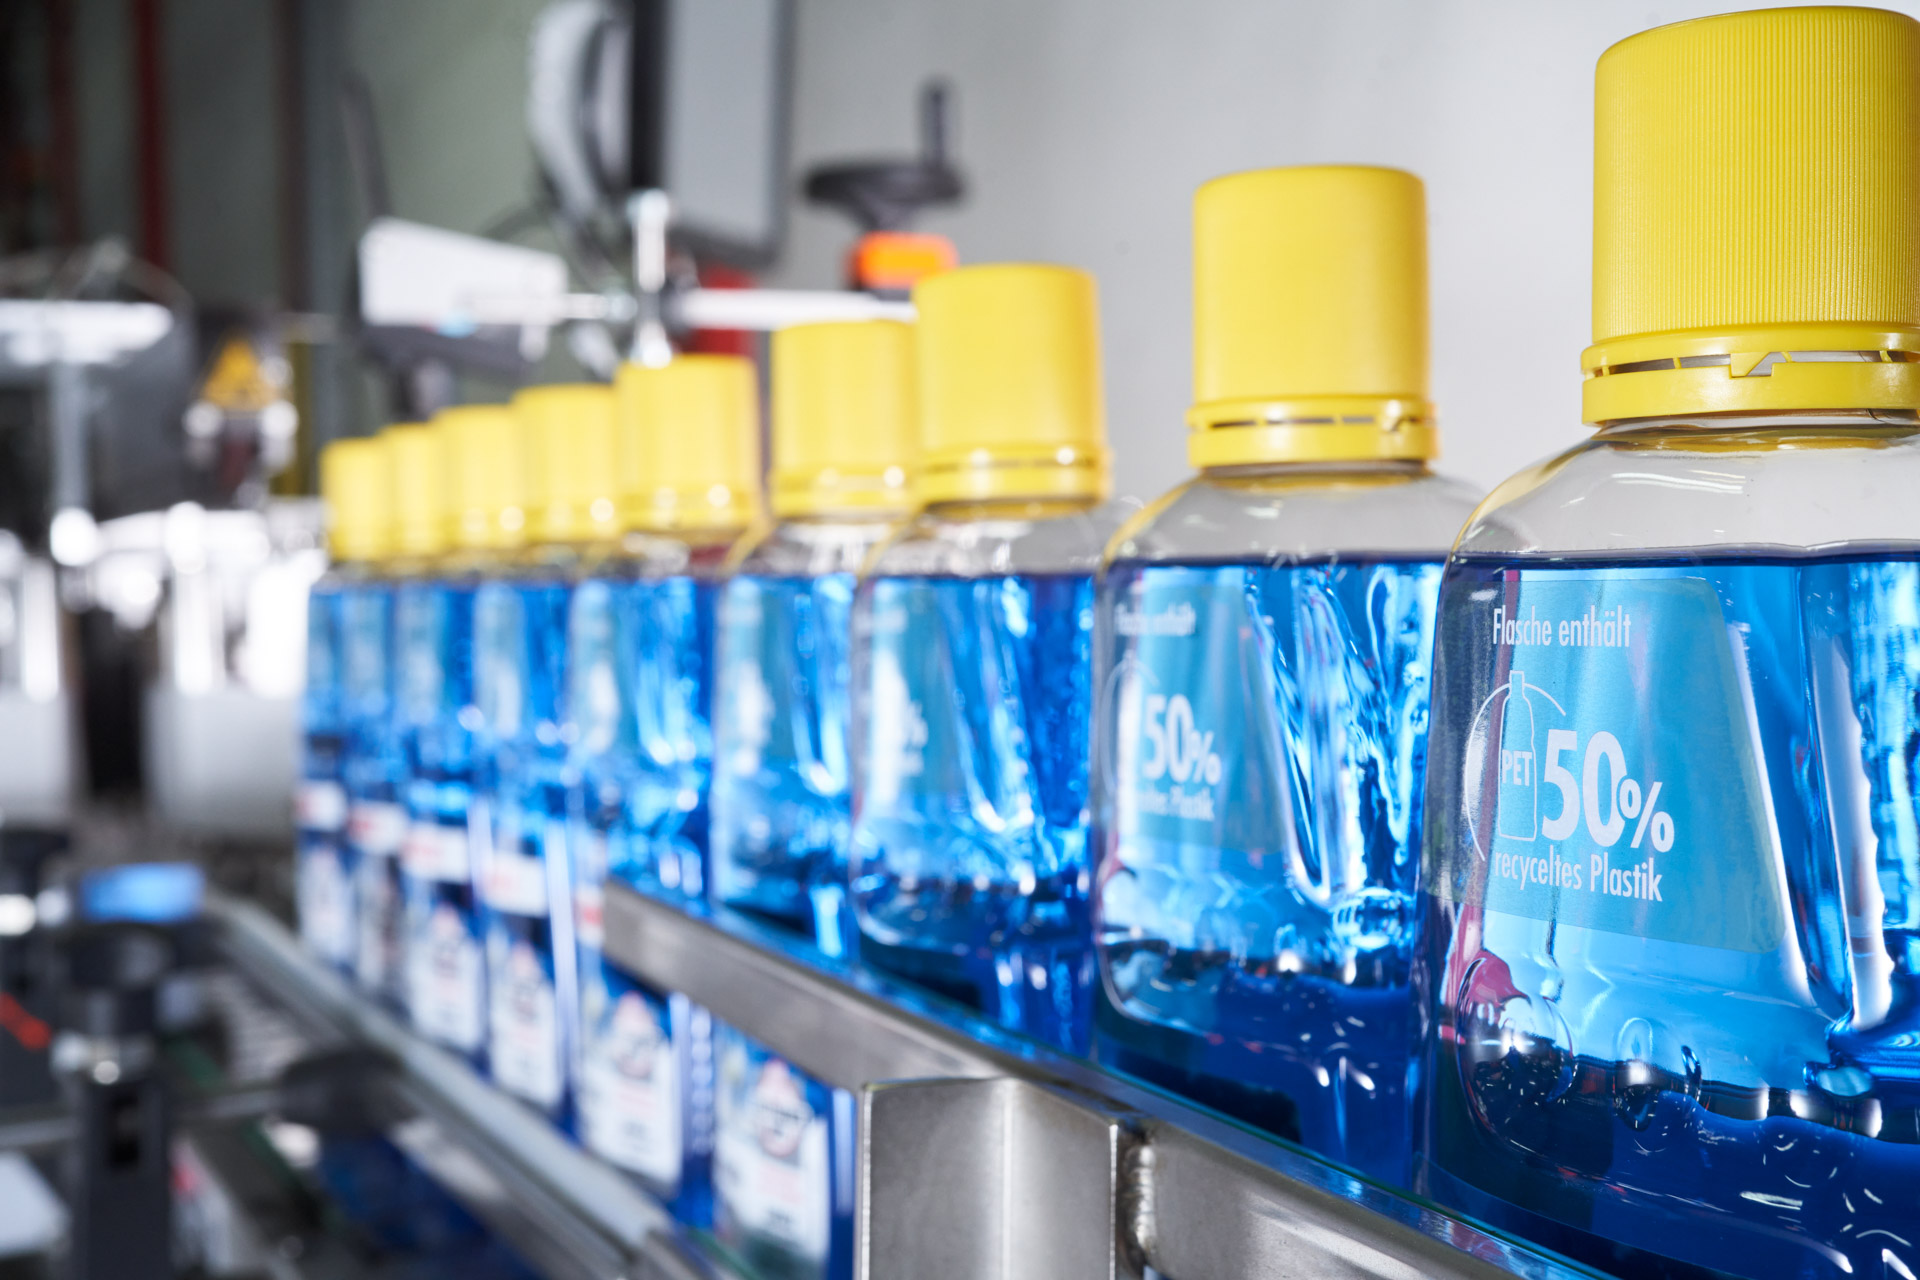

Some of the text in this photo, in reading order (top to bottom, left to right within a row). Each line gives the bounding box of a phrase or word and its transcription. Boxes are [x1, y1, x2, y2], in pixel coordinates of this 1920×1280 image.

[1493, 604, 1632, 647] Flasche enthält
[1143, 693, 1222, 785] 50%
[1501, 729, 1675, 852] PET 50%
[1494, 844, 1663, 902] recyceltes Plastik
